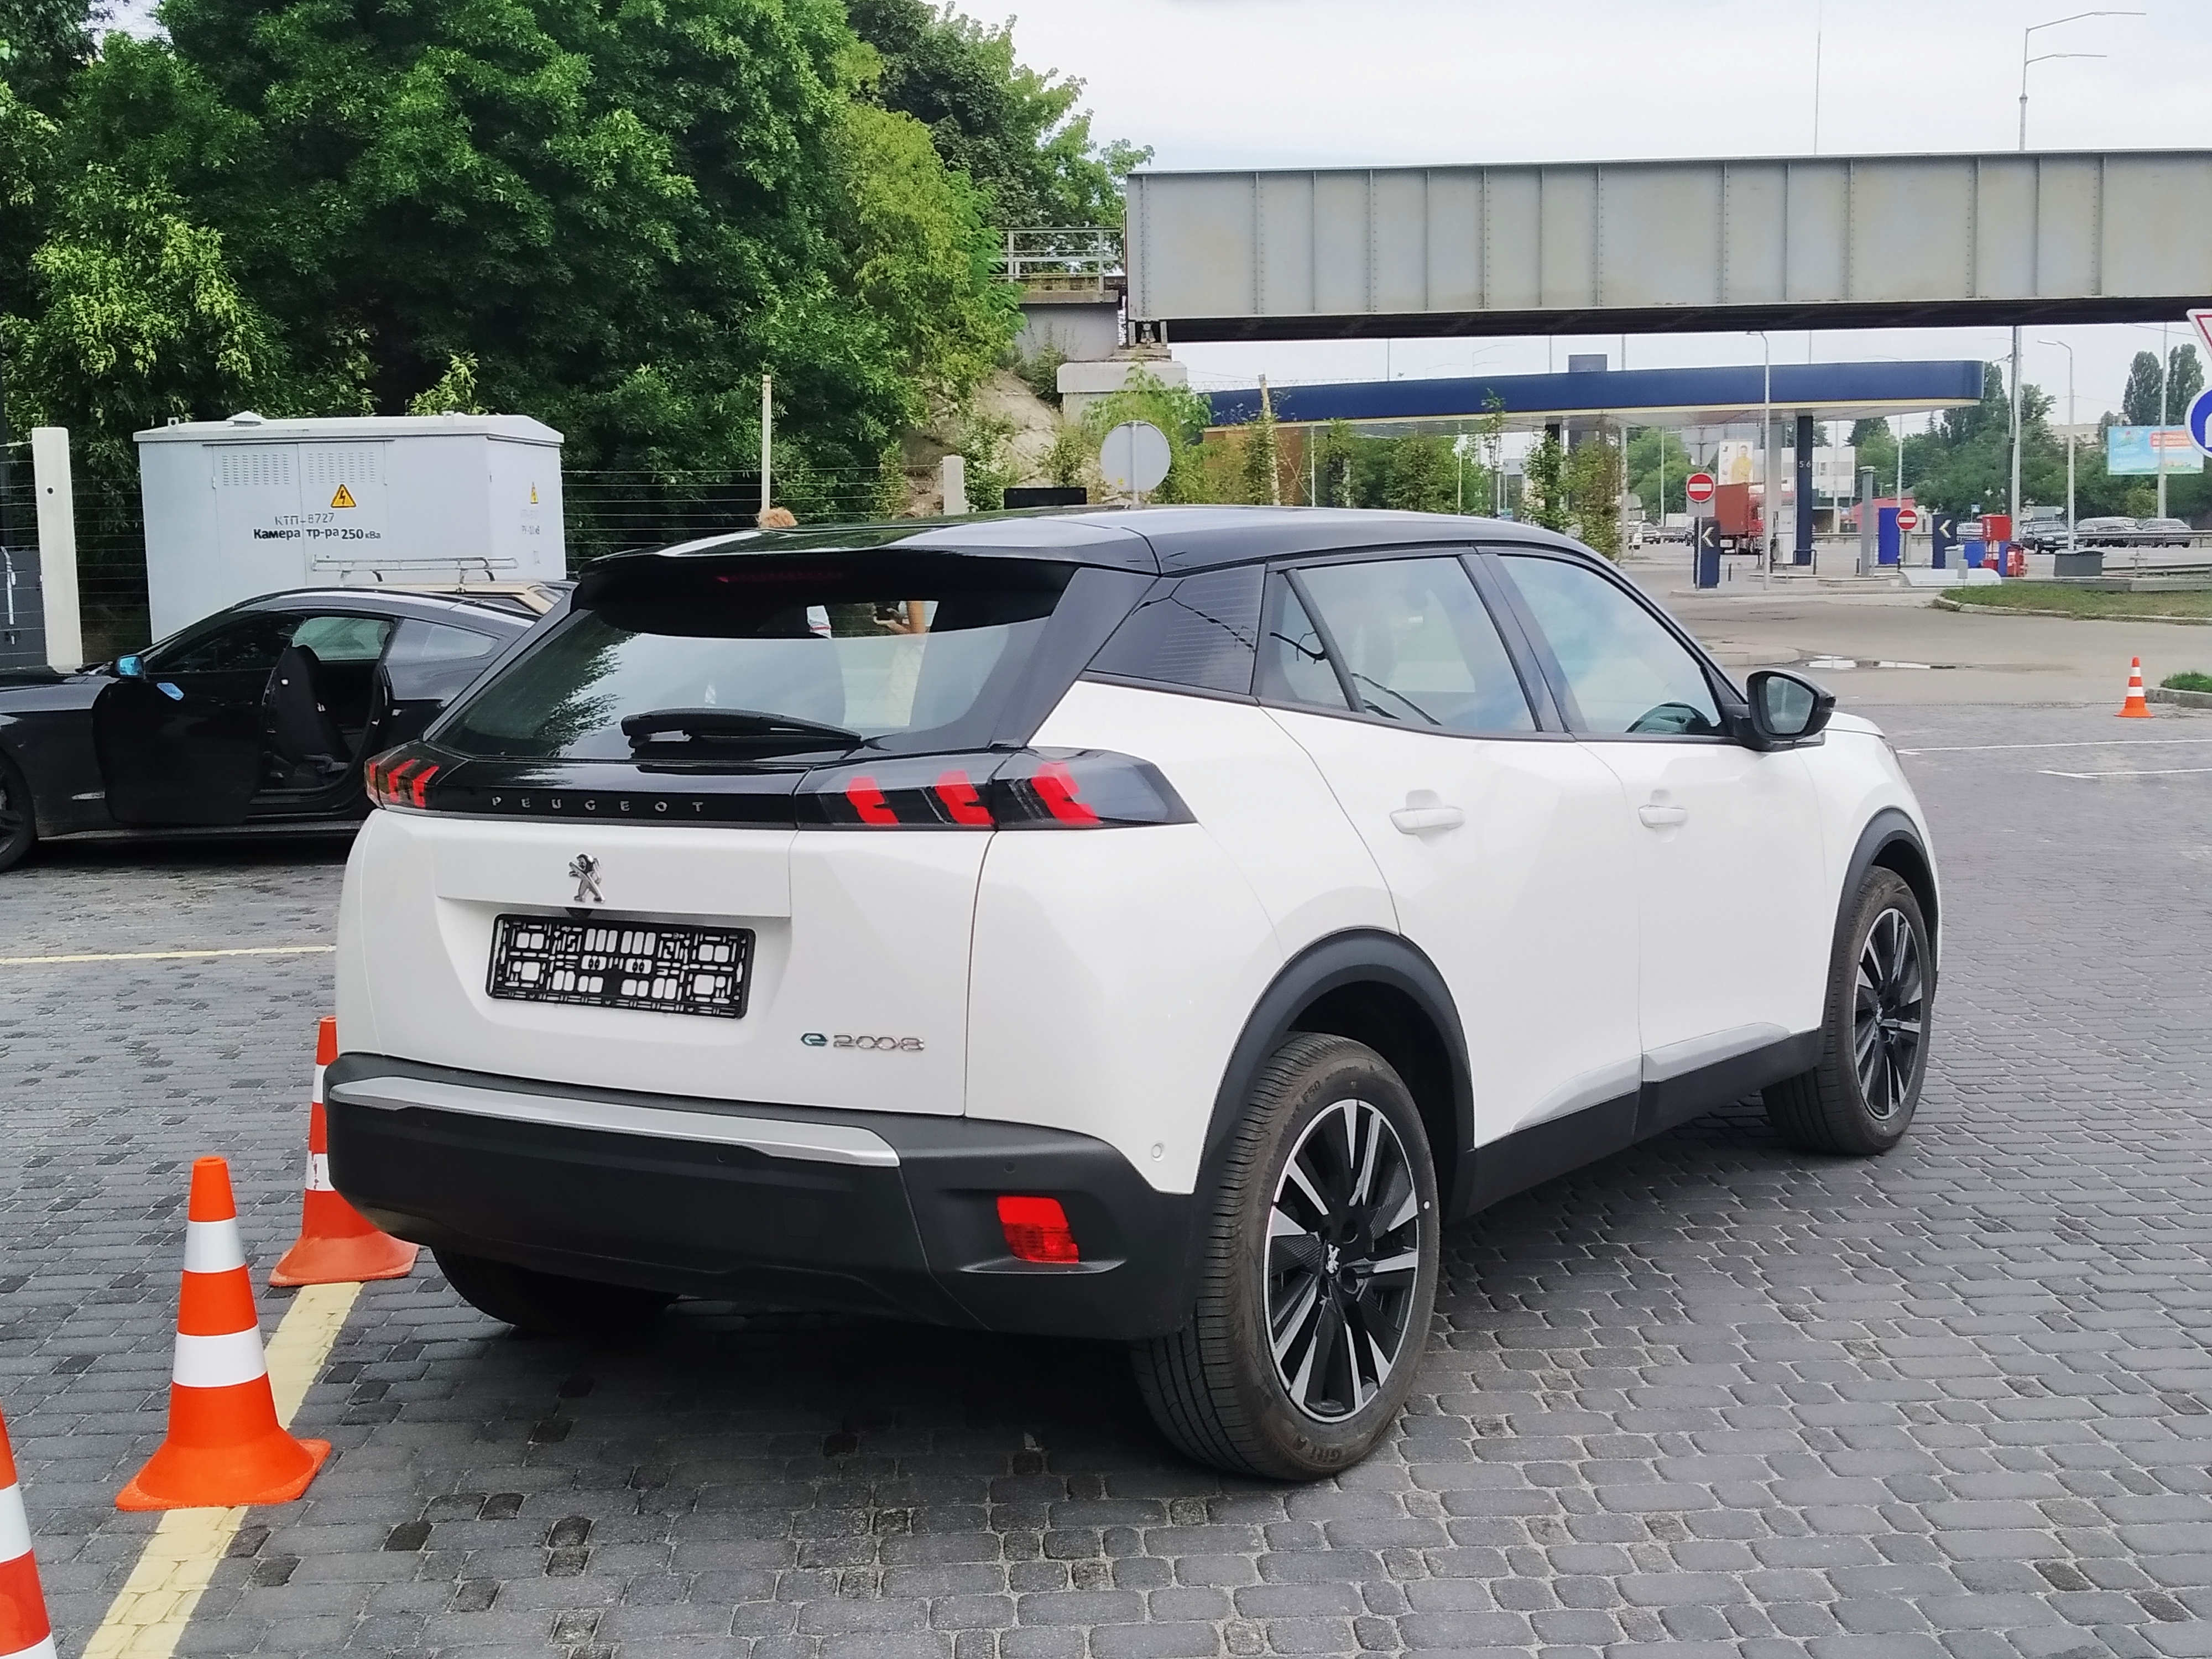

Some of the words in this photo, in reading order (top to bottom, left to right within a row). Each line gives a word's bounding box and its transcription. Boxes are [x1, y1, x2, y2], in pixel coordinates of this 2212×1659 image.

[253, 529, 301, 540] Камера
[306, 528, 339, 540] тр-ра
[341, 529, 364, 540] 250
[492, 796, 704, 812] PEUGEOT
